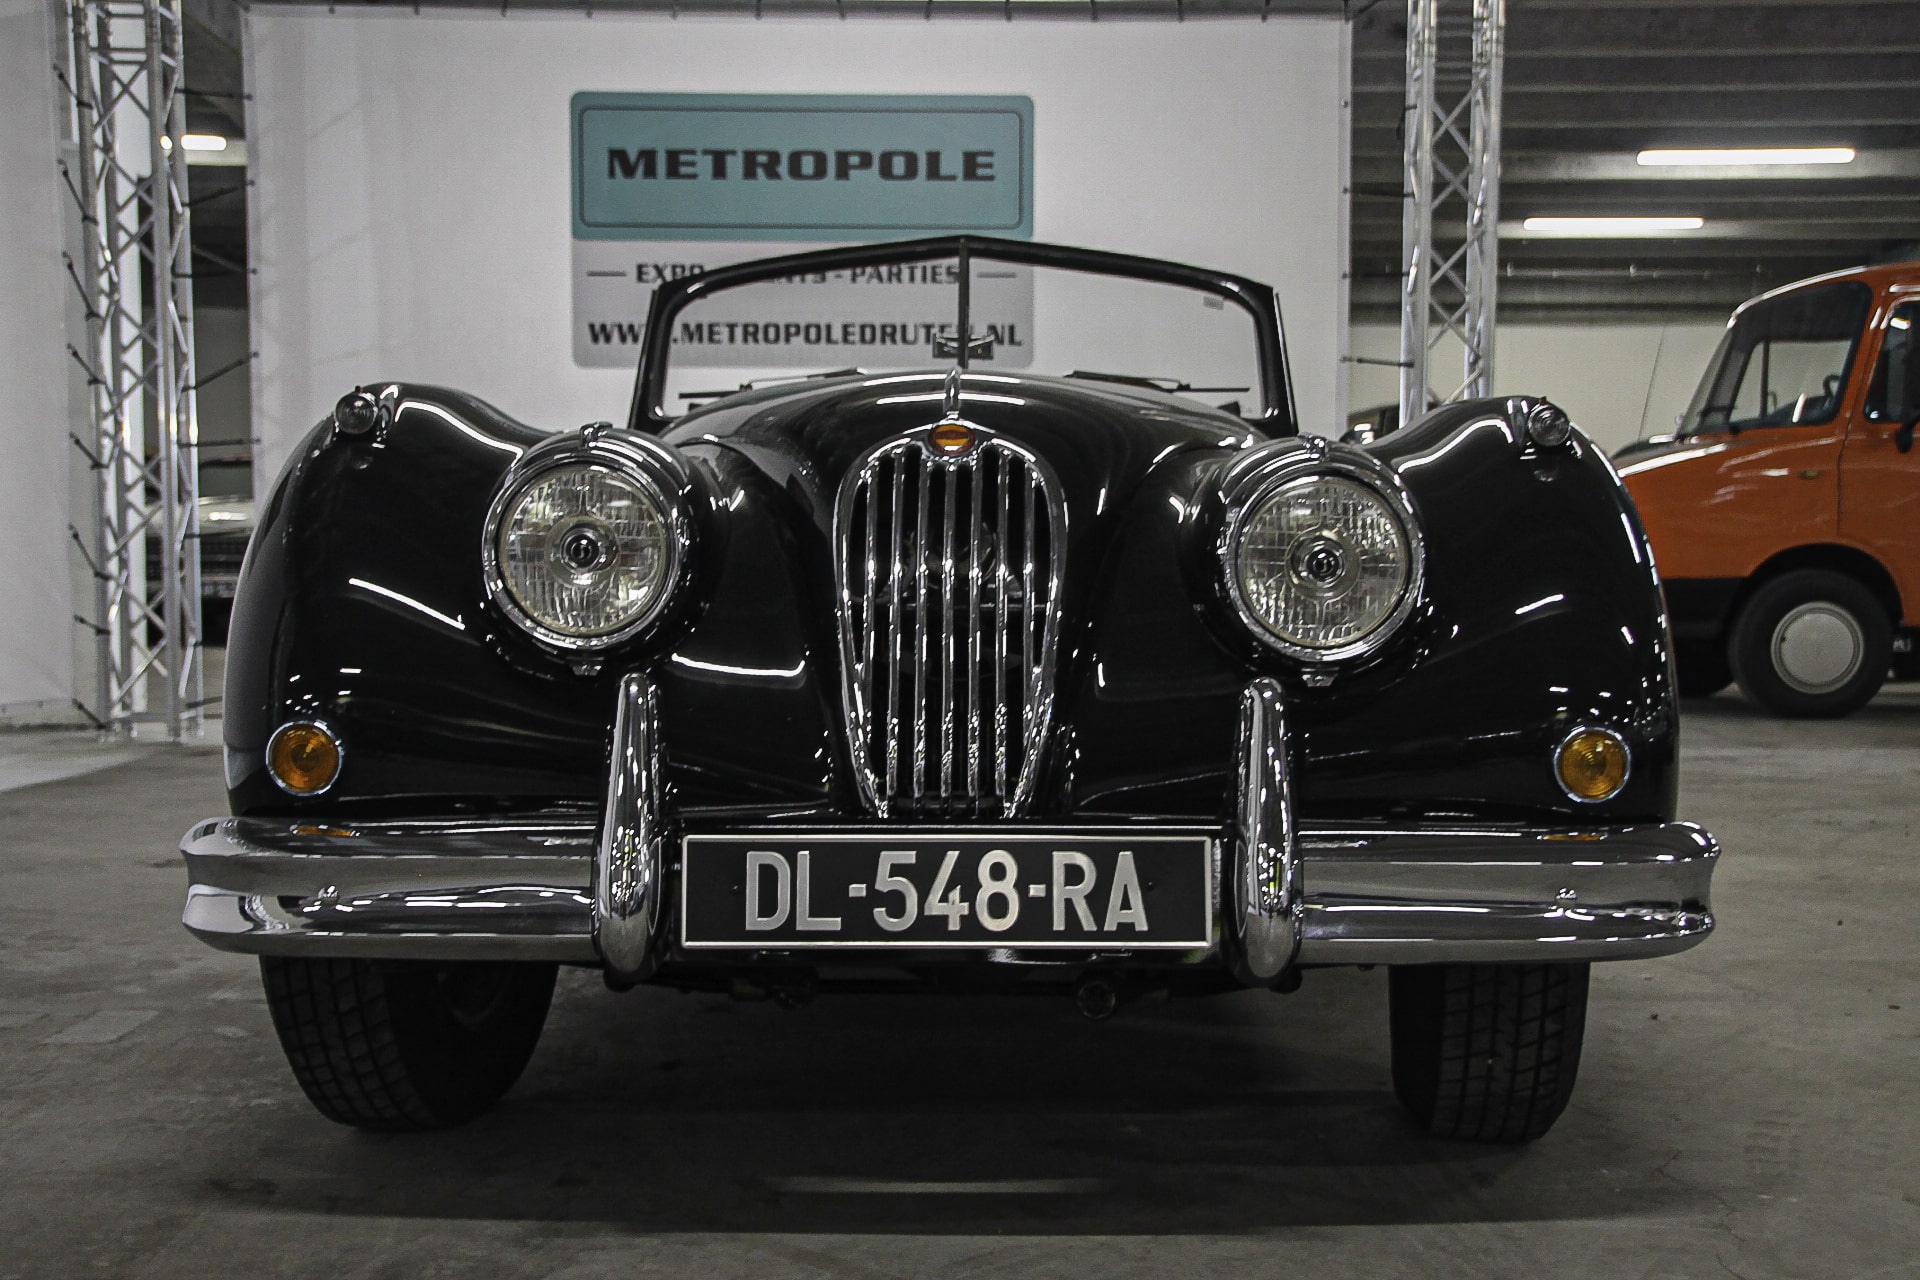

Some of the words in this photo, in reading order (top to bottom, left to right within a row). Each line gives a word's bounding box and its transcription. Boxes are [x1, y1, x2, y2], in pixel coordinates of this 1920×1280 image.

[607, 148, 996, 182] METROPOLE
[850, 264, 960, 284] PARTIES
[745, 850, 1149, 931] DL-548-RA
